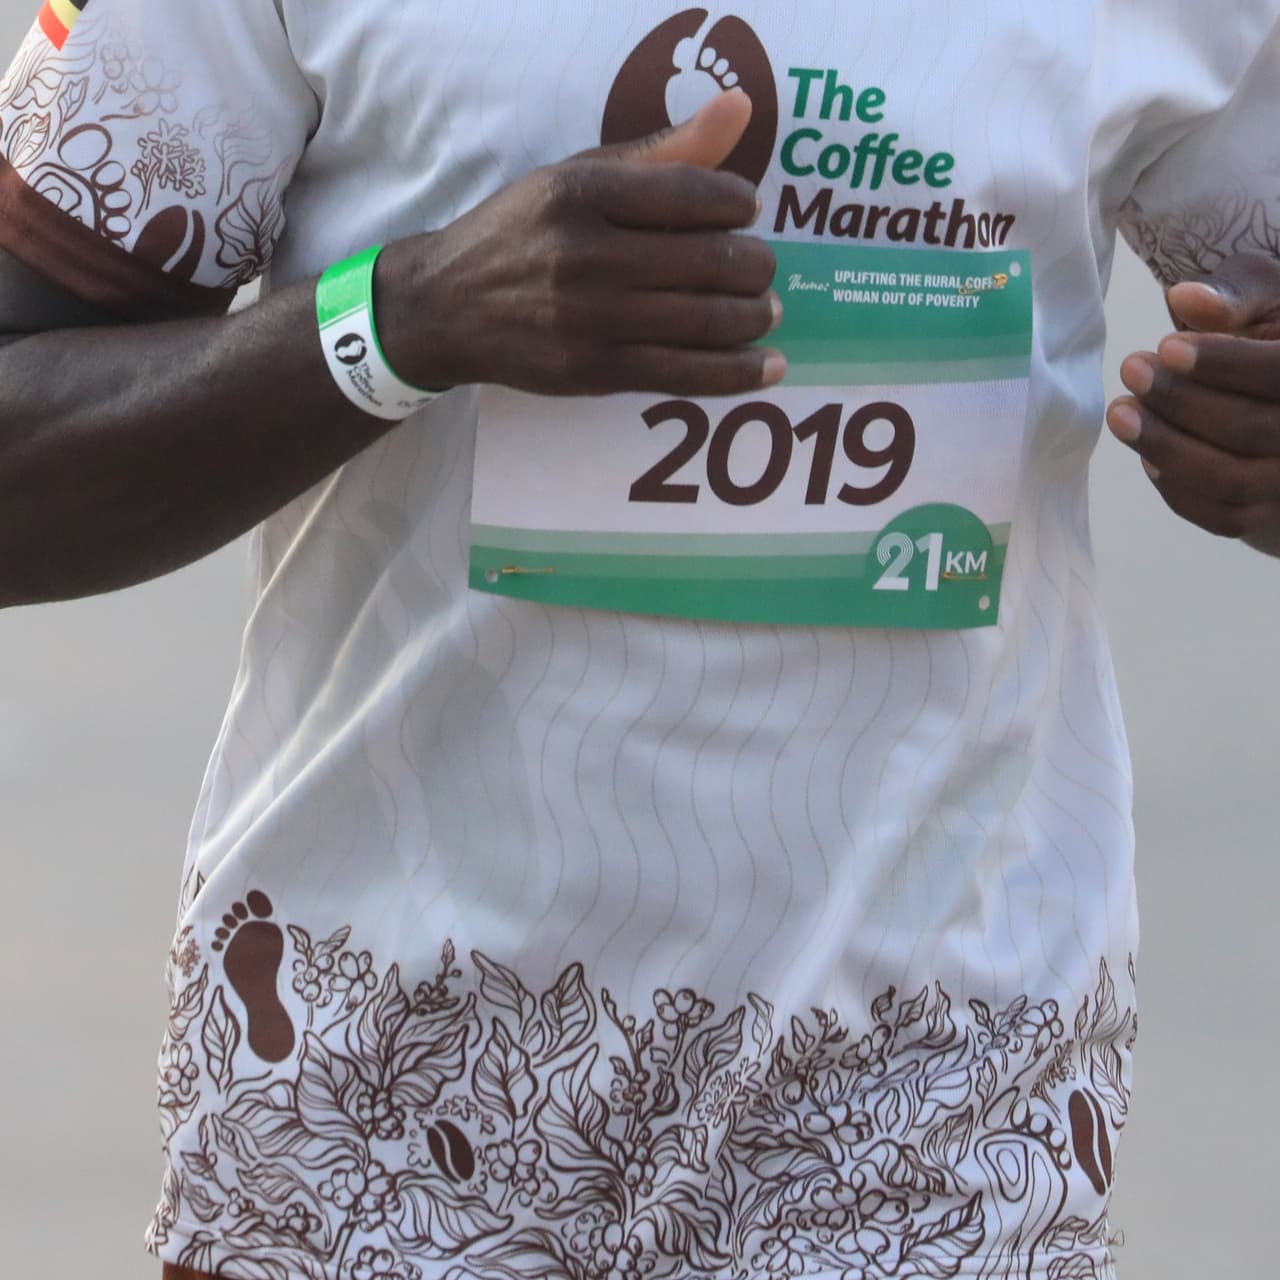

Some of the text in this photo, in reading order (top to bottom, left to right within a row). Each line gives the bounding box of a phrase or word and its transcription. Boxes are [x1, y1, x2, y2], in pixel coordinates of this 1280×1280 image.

[787, 67, 886, 123] The
[779, 128, 956, 190] Coffee
[772, 184, 1016, 249] Marathon
[833, 288, 980, 308] WOMAN OUT OF POVERTY
[834, 270, 896, 284] UPLIFTING
[899, 273, 923, 286] THE
[924, 274, 960, 289] RURAL
[627, 400, 916, 507] 2019
